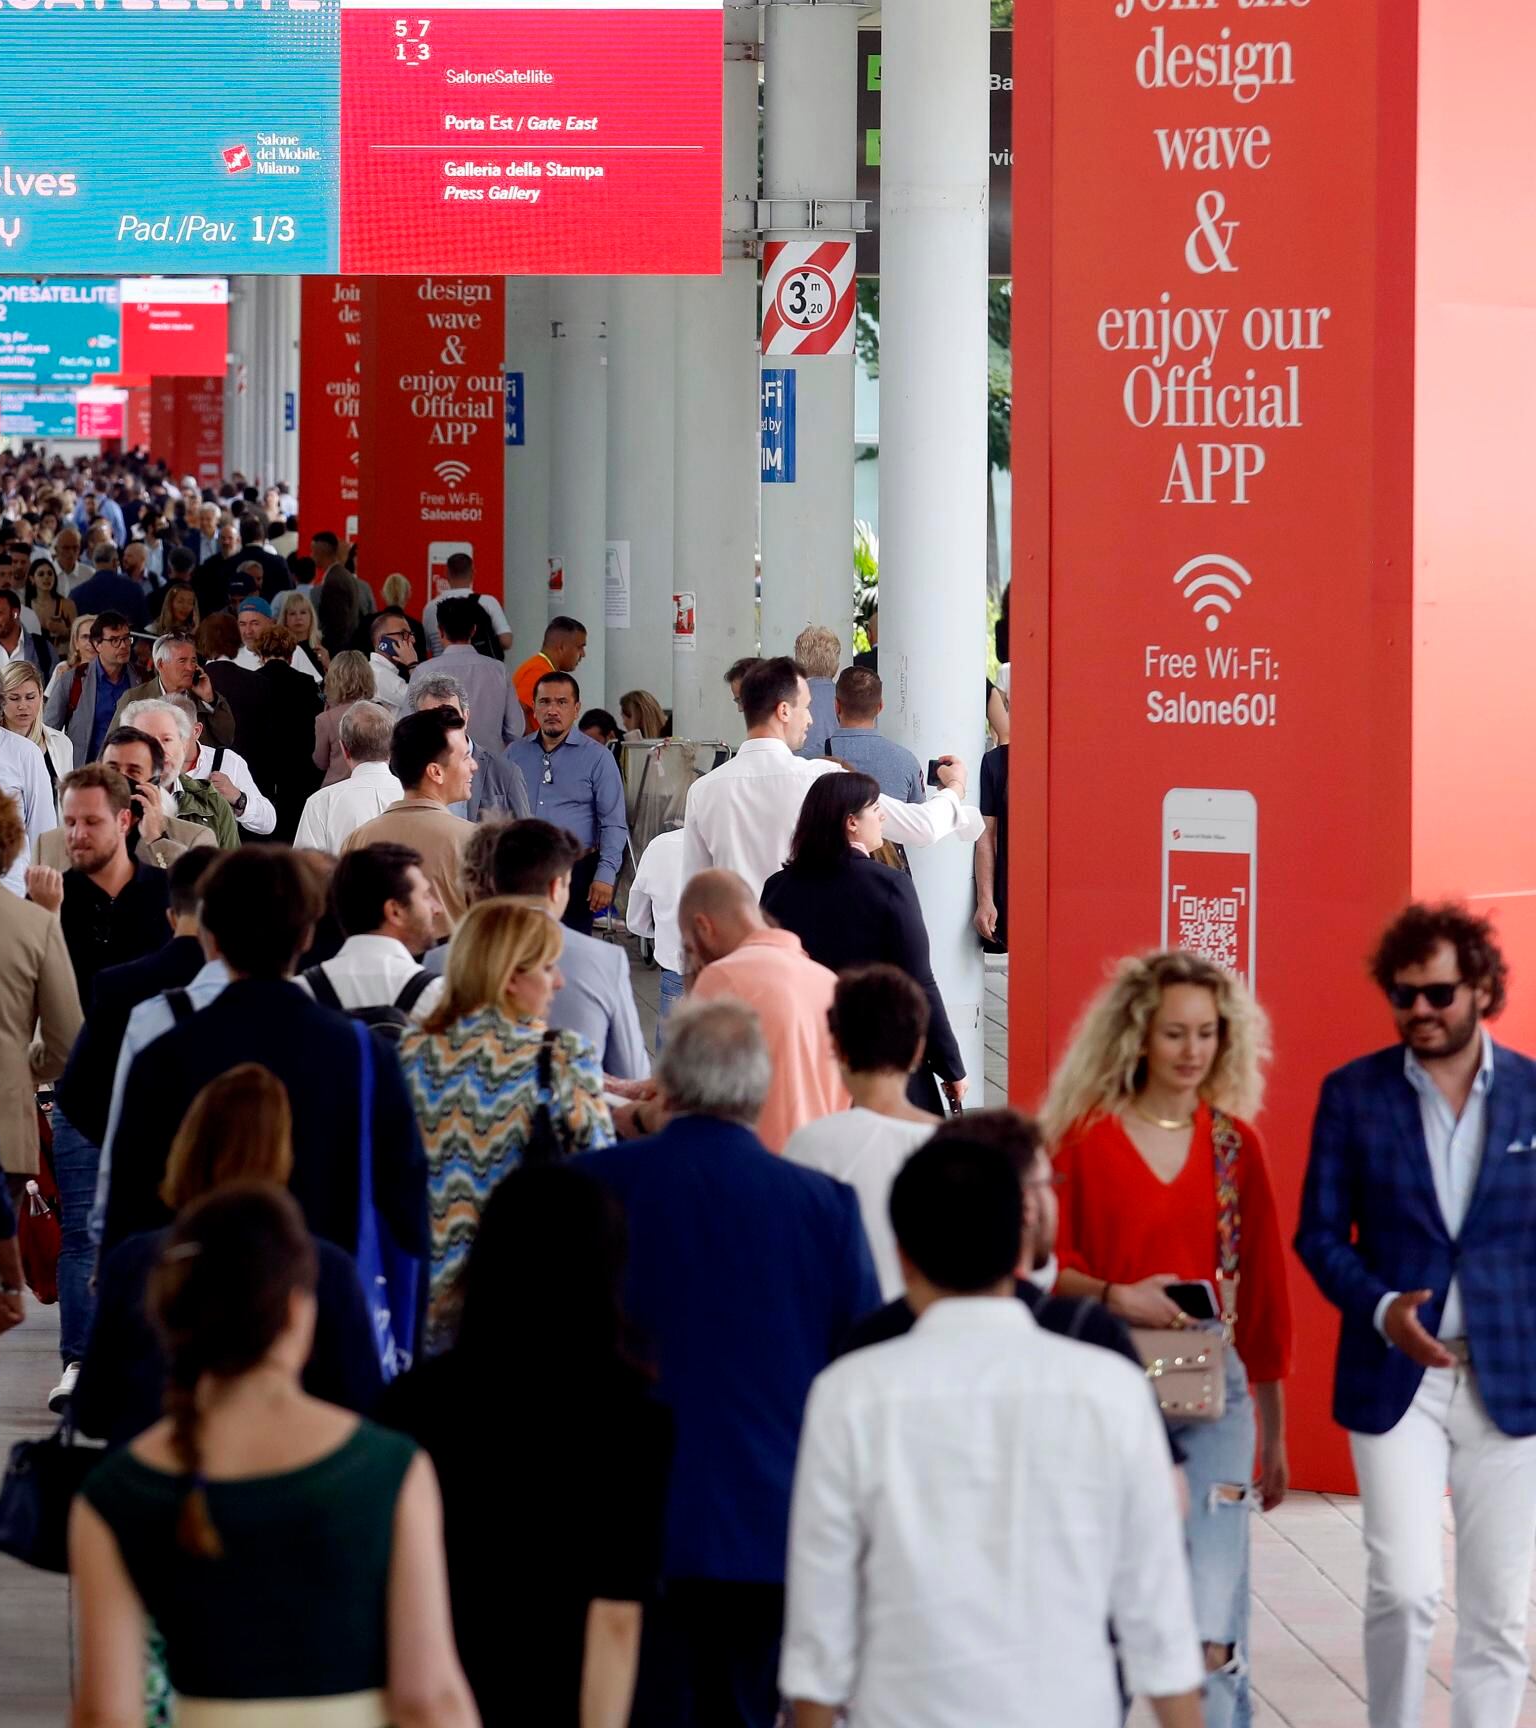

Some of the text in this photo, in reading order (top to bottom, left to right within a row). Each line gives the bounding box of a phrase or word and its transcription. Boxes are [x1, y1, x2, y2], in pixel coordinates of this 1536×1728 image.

[395, 20, 430, 43] 5_7
[395, 44, 430, 66] 1_3
[1135, 26, 1296, 103] design
[446, 69, 553, 86] SaloneSatellite
[445, 115, 484, 131] Porta
[489, 115, 513, 130] Est
[527, 116, 561, 131] Gate
[565, 116, 598, 131] East
[256, 132, 299, 146] Salone
[1153, 125, 1271, 171] wave
[257, 148, 276, 160] del
[256, 162, 300, 175] Milano
[444, 161, 604, 180] Galleria della Stampa
[444, 185, 541, 205] Press Gallery
[117, 215, 296, 242] Pad./Pav. 1/3
[1184, 190, 1240, 275] &
[417, 278, 491, 304] design
[789, 281, 821, 315] 3 m
[427, 314, 481, 330] wave
[1097, 291, 1331, 367] enjoy our
[440, 335, 465, 365] &
[325, 377, 361, 400] enjo
[399, 370, 459, 397] enjoy
[761, 380, 783, 408] -Fi
[1123, 363, 1303, 427] Official
[411, 394, 495, 419] Official
[428, 422, 478, 445] APP
[769, 416, 782, 434] by
[761, 447, 782, 471] IM
[1160, 443, 1266, 504] APP
[420, 492, 484, 506] Free Wi-Fi:
[420, 508, 483, 521] Salone60!
[1145, 645, 1280, 681] Free Wi-Fi:
[1146, 691, 1276, 726] Salone60!
